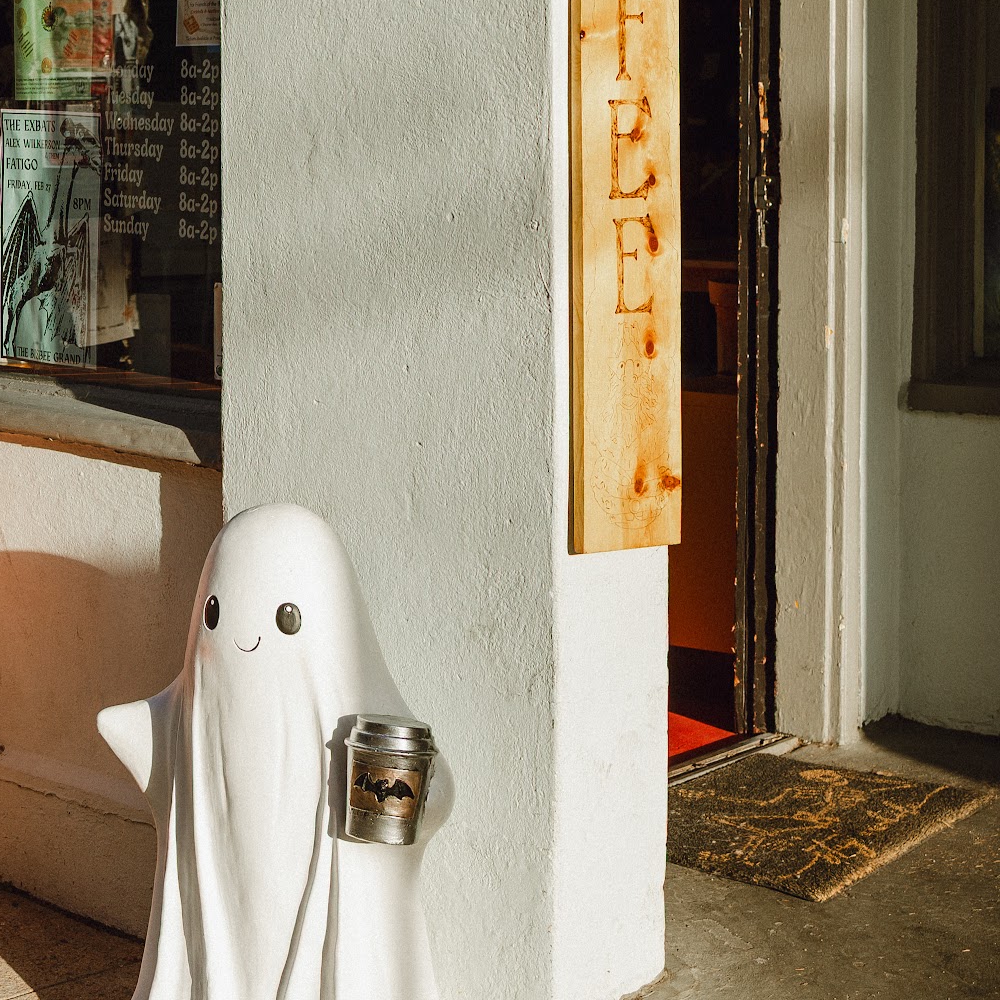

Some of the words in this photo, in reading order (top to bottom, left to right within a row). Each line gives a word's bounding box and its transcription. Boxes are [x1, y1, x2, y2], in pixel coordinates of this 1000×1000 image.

[108, 62, 154, 83] onday
[181, 59, 219, 83] 8a-2p
[105, 85, 154, 109] Tuesday
[181, 85, 219, 110] 8a-2p
[4, 119, 20, 131] THE
[24, 119, 56, 133] EXBATS
[105, 111, 174, 136] Wednesday
[180, 112, 219, 137] 8a-2p
[5, 138, 20, 148] ALEX
[23, 138, 61, 150] WILKERSON
[104, 136, 163, 162] Thursday
[180, 139, 219, 164] 8a-2p
[6, 157, 38, 171] FATIGO
[7, 179, 32, 191] FRIDAY,
[34, 180, 44, 191] FEB
[45, 183, 52, 193] 27
[104, 162, 143, 187] Friday
[180, 165, 218, 191] 8a-2p
[73, 198, 92, 210] 8PM
[103, 188, 161, 214] Saturday
[179, 192, 218, 218] 8a-2p
[103, 213, 149, 241] Sunday
[179, 218, 217, 245] 8a-2p
[17, 346, 28, 358] THE
[53, 351, 81, 365] GRAND
